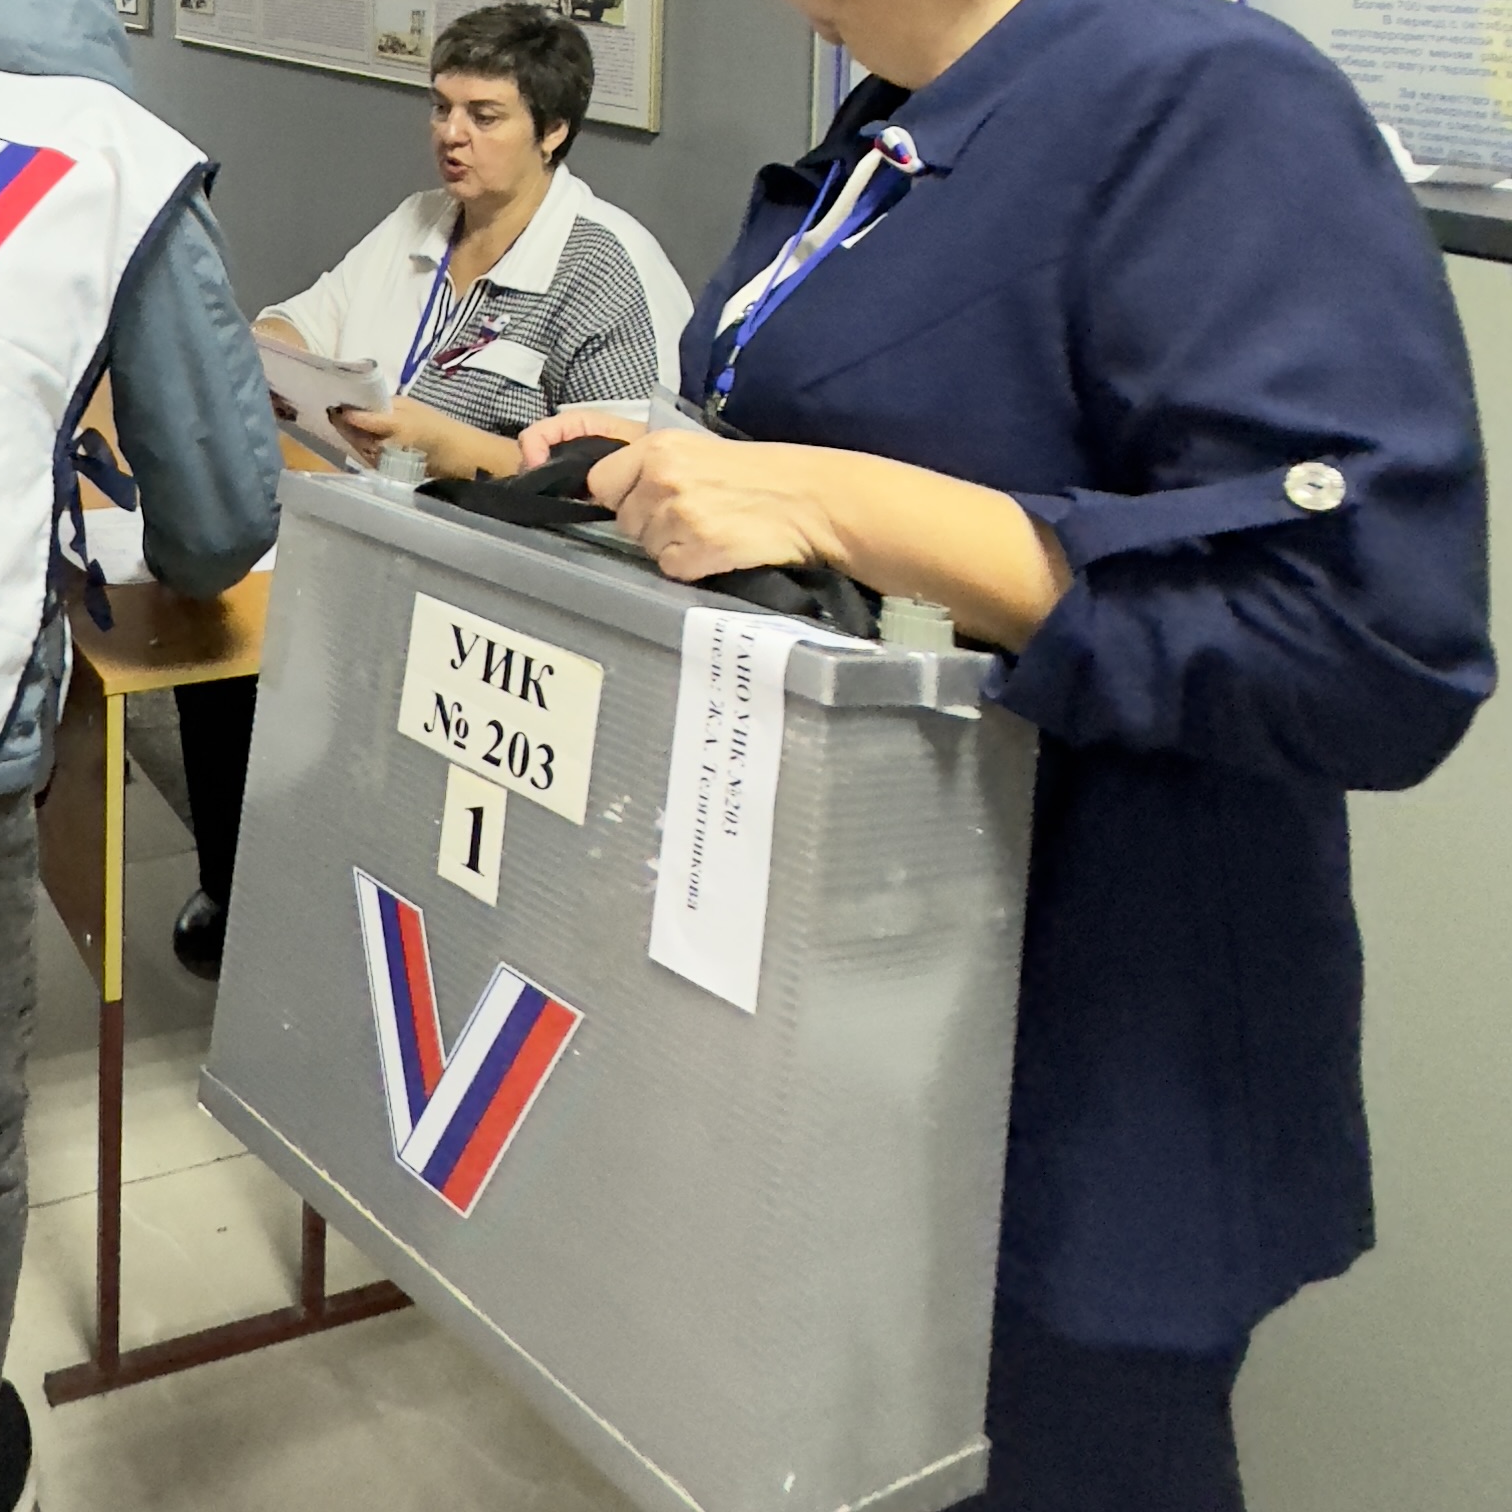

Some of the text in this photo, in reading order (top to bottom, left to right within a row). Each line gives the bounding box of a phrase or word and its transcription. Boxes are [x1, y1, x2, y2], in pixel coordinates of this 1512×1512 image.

[449, 623, 555, 712] УИК
[735, 628, 755, 702] ТАНО
[423, 692, 556, 792] № 203
[729, 709, 750, 767] УИК
[460, 805, 486, 877] 1
